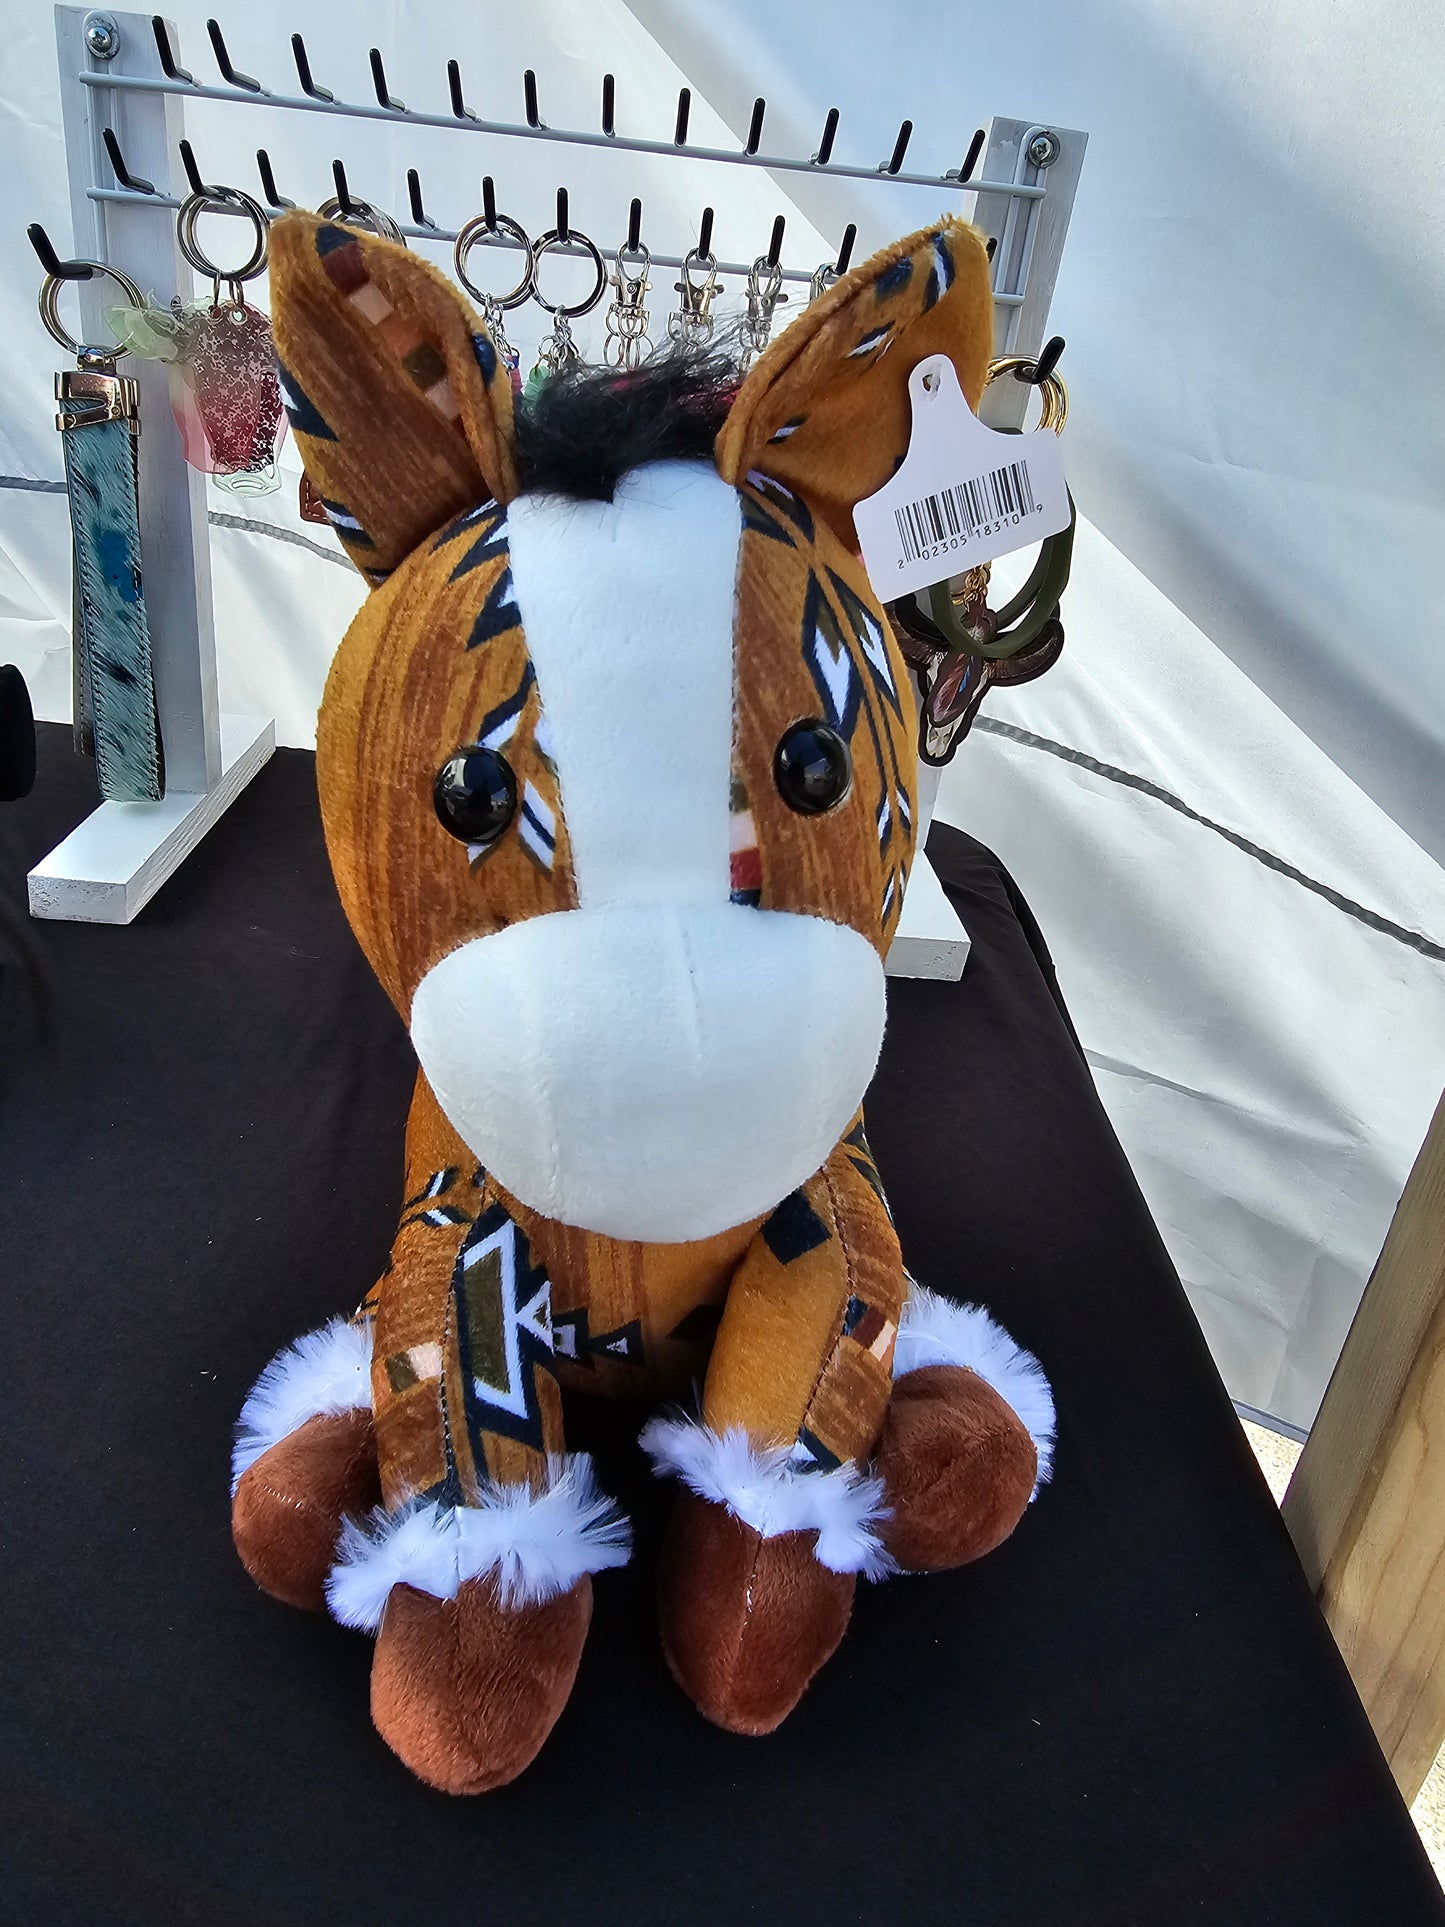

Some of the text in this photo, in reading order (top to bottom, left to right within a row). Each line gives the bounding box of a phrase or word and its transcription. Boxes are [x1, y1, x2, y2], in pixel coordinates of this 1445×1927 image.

[897, 503, 1043, 570] 2 02305 18310 9
